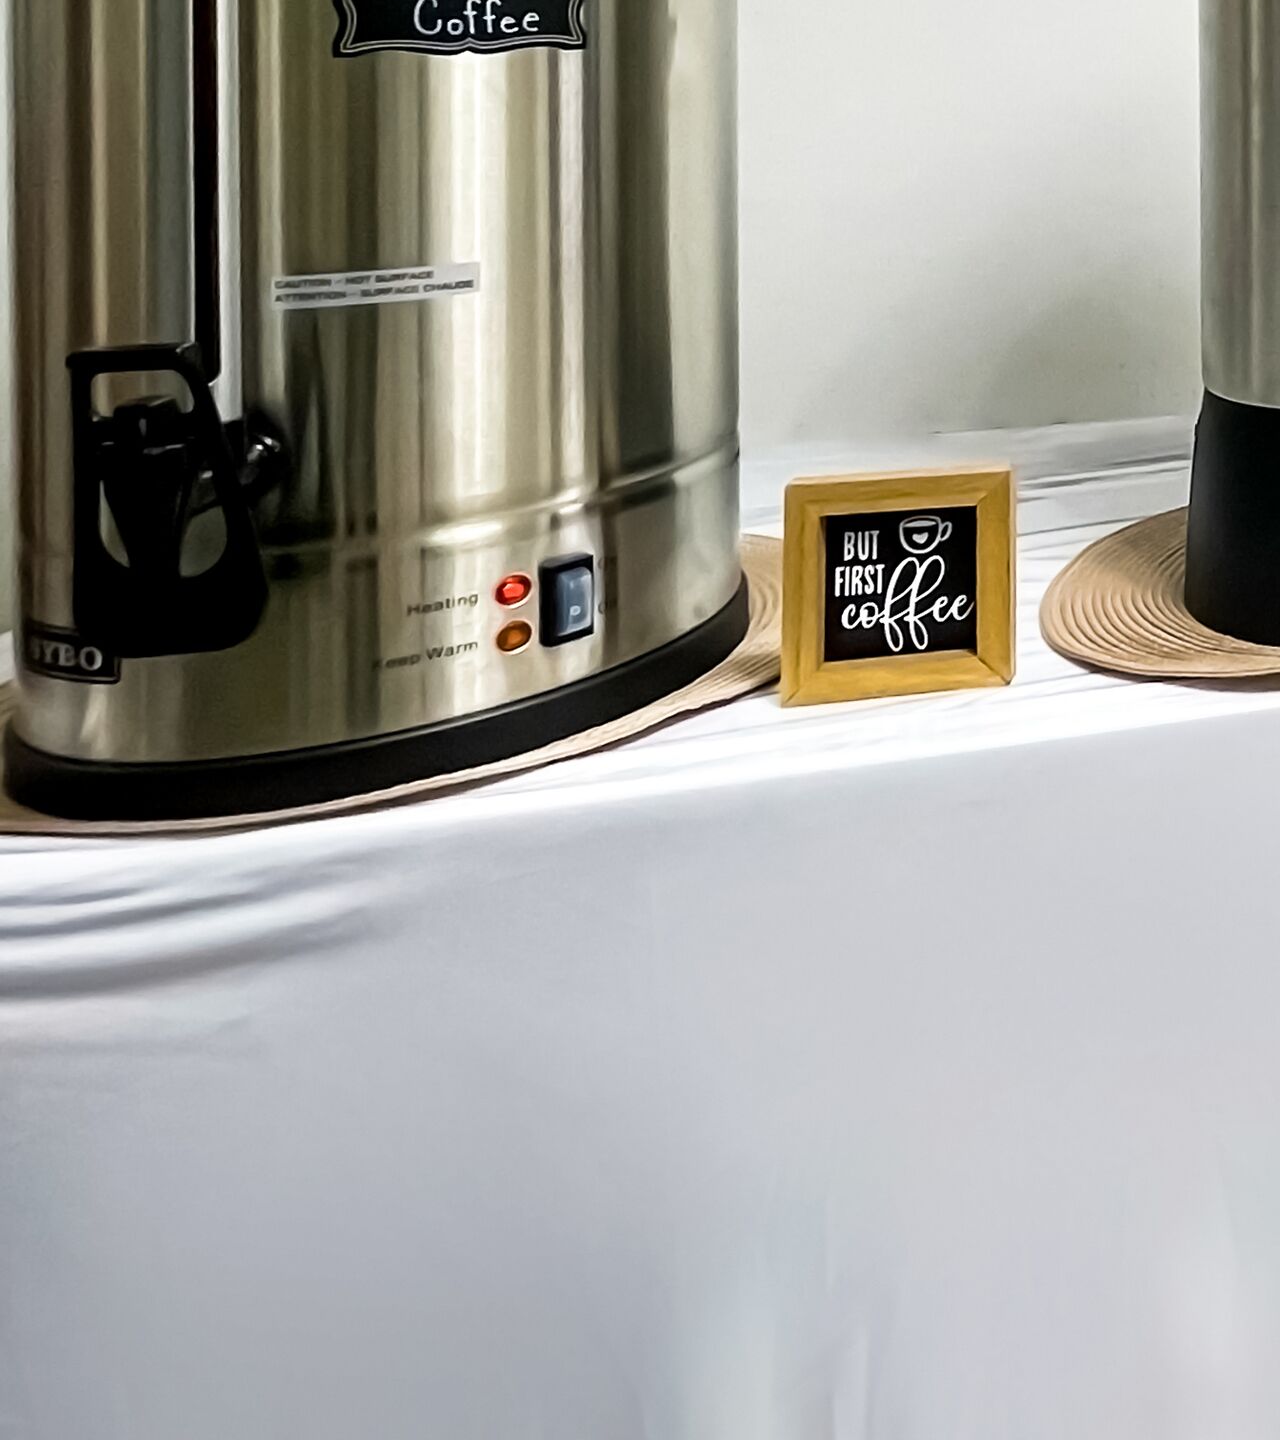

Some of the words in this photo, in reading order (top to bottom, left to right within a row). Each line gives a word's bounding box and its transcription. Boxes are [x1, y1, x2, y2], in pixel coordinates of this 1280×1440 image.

[274, 278, 332, 290] CAUTION
[345, 274, 373, 286] HOT
[375, 270, 435, 284] SURFACE
[274, 291, 347, 303] ATTENTION
[360, 283, 420, 297] SURFACE
[423, 278, 475, 293] CHAUDE
[843, 529, 881, 562] BUT
[834, 563, 886, 598] FIRST
[406, 593, 480, 617] Heating
[841, 554, 976, 653] coffee
[426, 640, 480, 662] Warm
